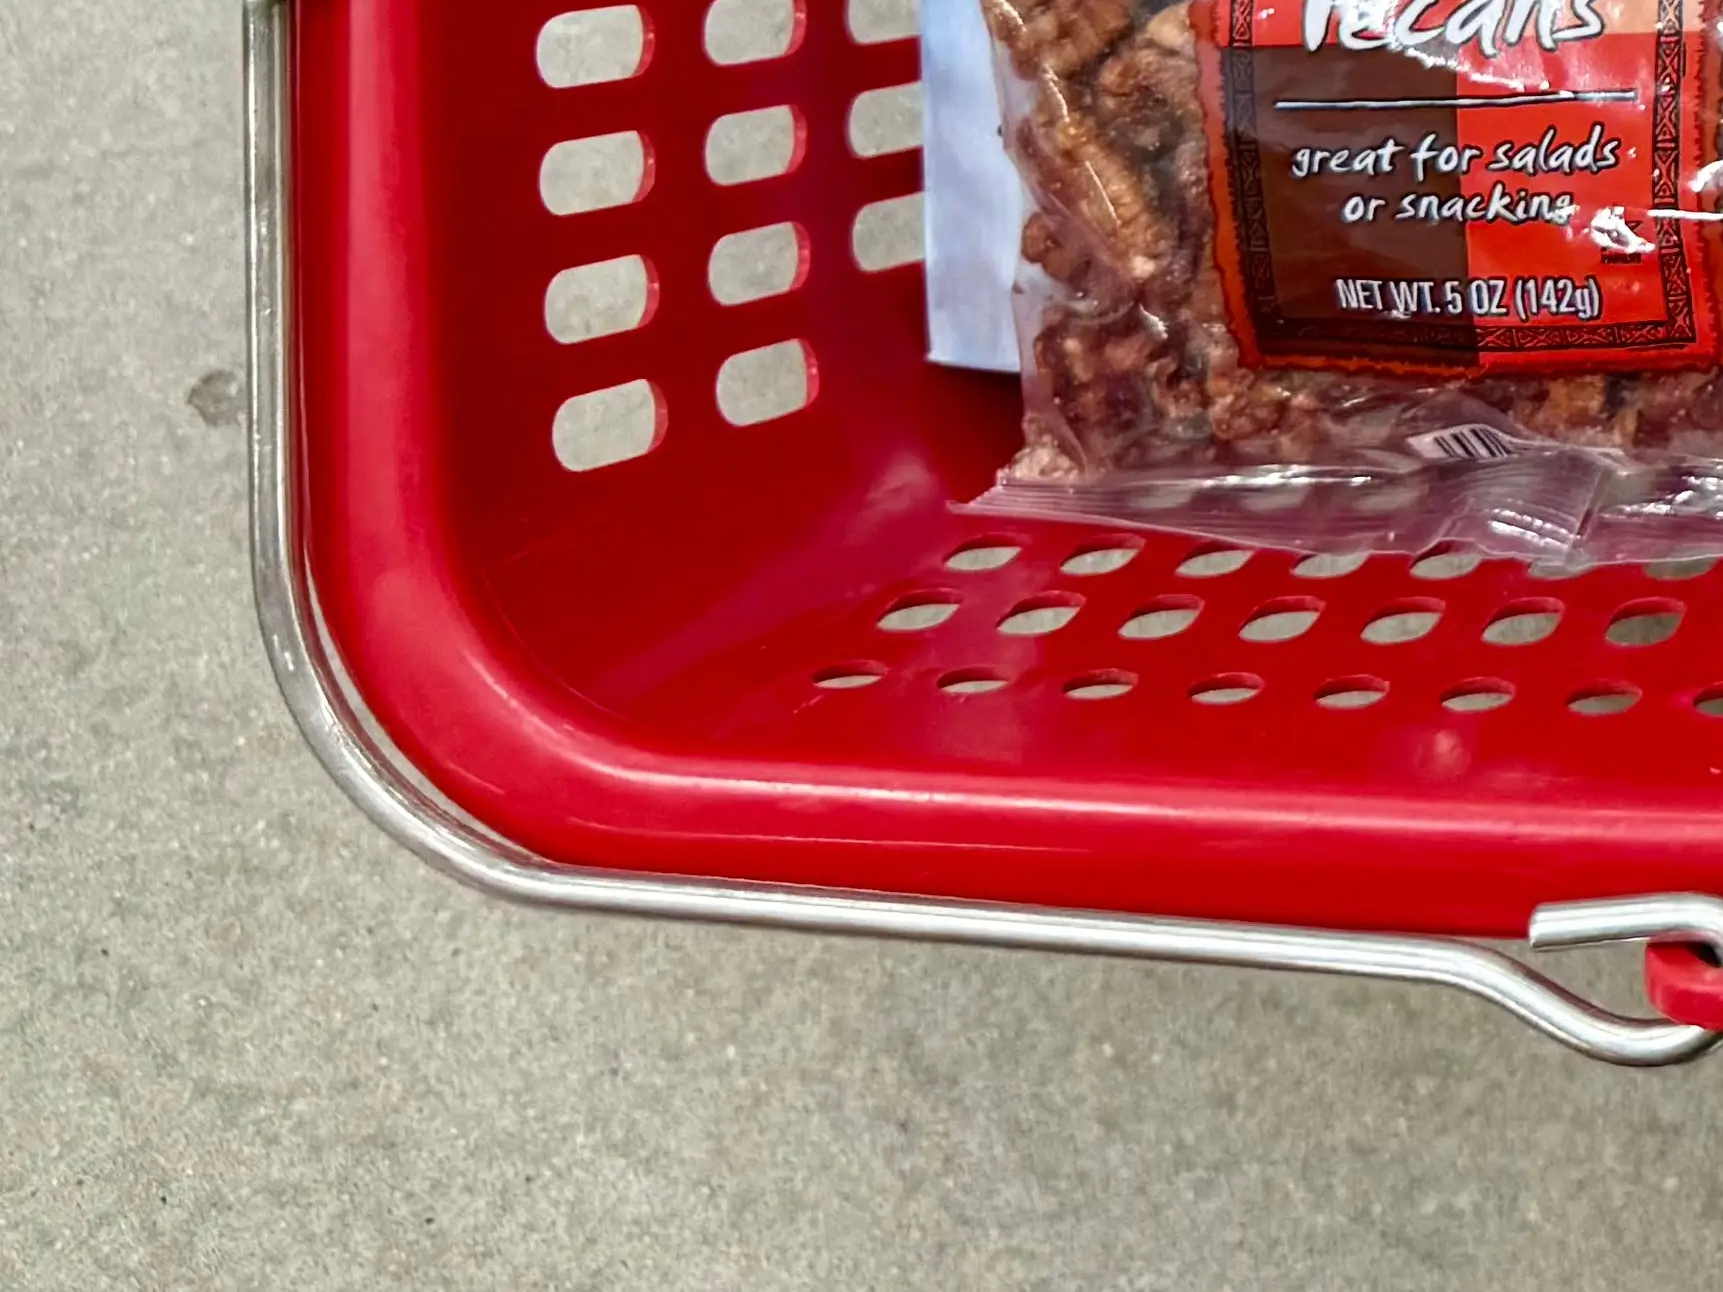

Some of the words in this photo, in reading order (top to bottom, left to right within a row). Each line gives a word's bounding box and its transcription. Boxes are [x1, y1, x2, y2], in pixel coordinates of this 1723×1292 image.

[1290, 136, 1405, 179] great
[1410, 132, 1483, 183] for
[1487, 121, 1622, 176] salads
[1342, 194, 1386, 224] or
[1395, 181, 1575, 227] snacking
[1336, 278, 1383, 311] NET
[1390, 279, 1442, 314] WT.
[1443, 279, 1463, 314] 5
[1470, 278, 1507, 314] OZ
[1514, 276, 1602, 321] (142g)
